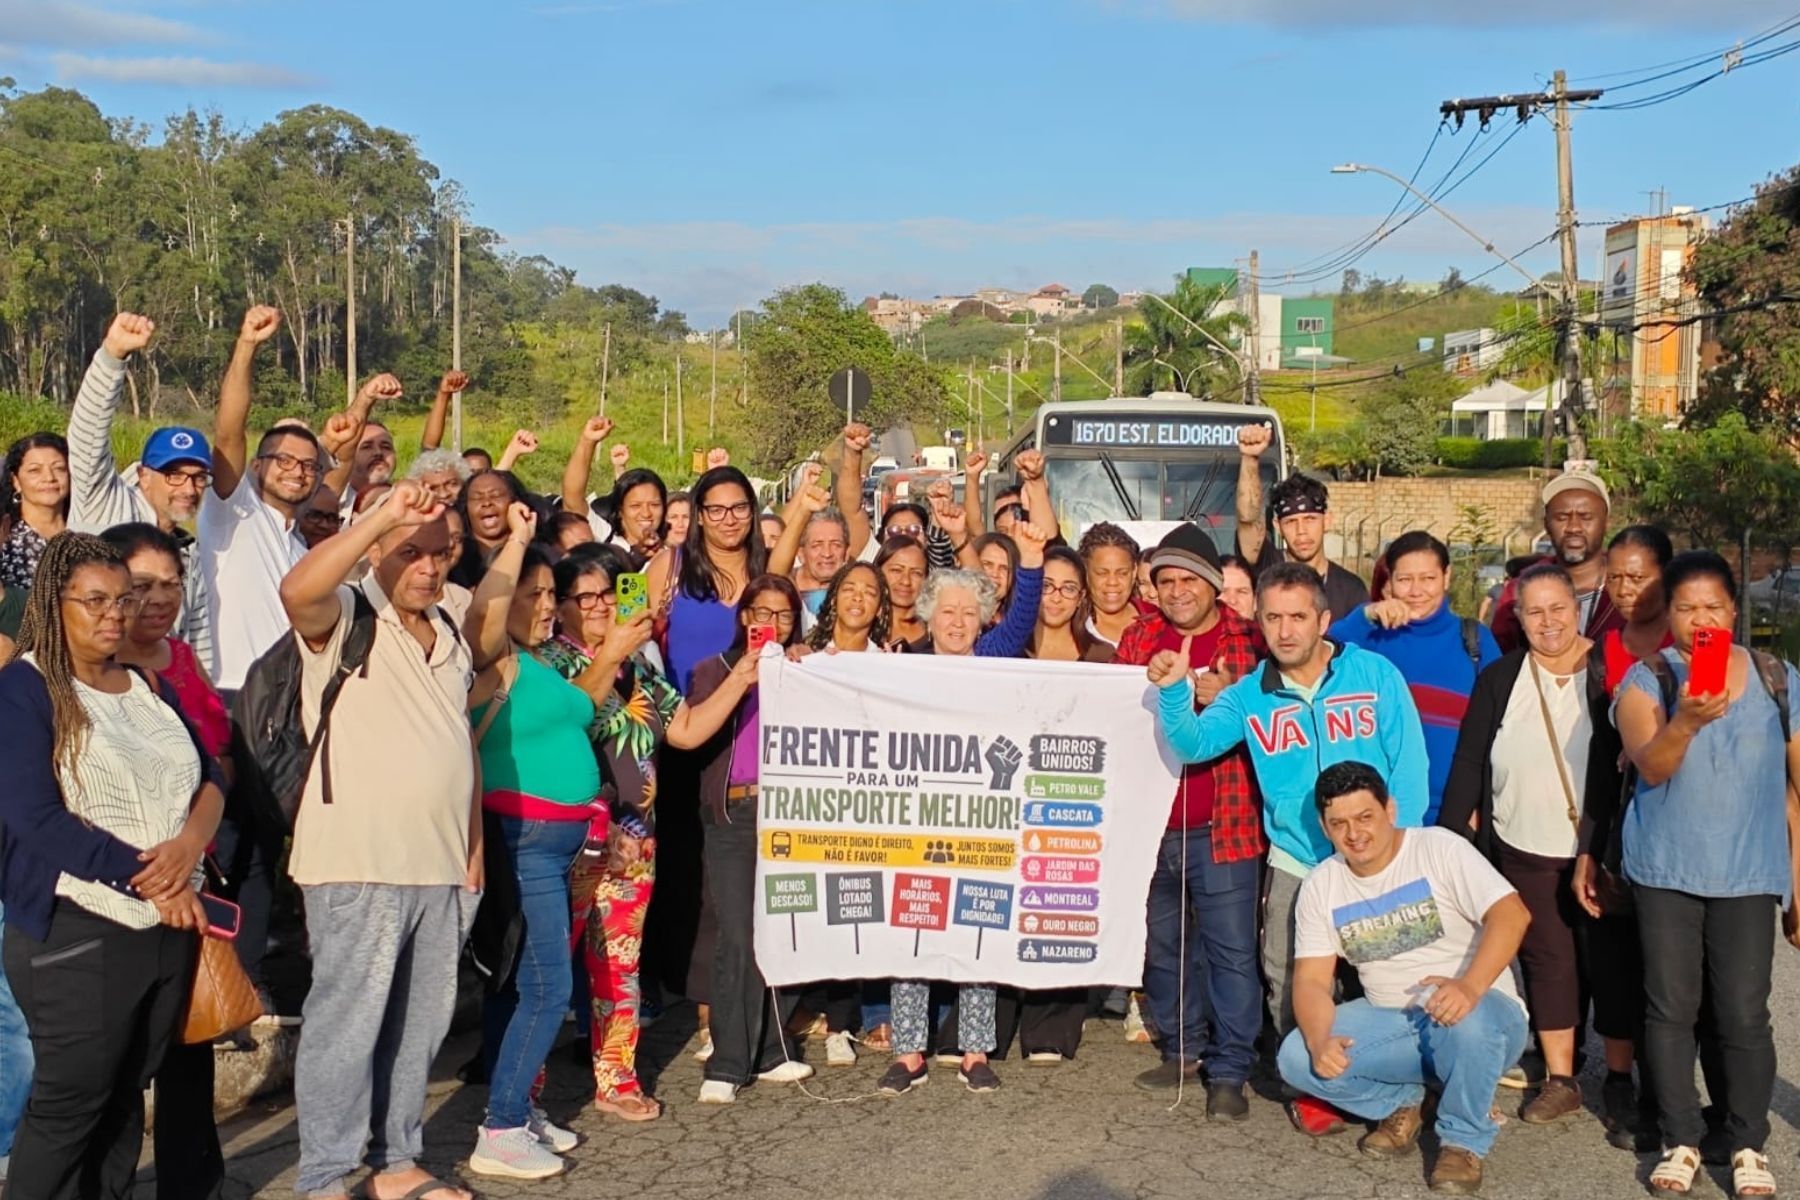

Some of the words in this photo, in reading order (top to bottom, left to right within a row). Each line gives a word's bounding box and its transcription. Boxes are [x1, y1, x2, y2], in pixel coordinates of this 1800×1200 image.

[1076, 423, 1115, 443] 1670
[1119, 423, 1154, 444] EST.
[1248, 705, 1378, 755] VANS
[763, 725, 879, 769] FRENTE
[888, 732, 982, 774] UNIDA
[1040, 738, 1096, 755] BAIRROS
[1041, 754, 1094, 770] UNIDOS!
[847, 772, 889, 786] PARA
[895, 774, 918, 787] UM
[1049, 783, 1076, 794] PETRO
[1078, 785, 1099, 795] VALE
[762, 786, 912, 825] TRANSPORTE
[919, 793, 1020, 830] MELHOR!
[1048, 808, 1094, 822] CASCATA
[798, 834, 848, 847] TRANSPORTE
[849, 837, 874, 848] DIGNO
[875, 836, 880, 848] É
[881, 838, 914, 850] DIREITO,
[956, 841, 985, 852] JUNTOS
[988, 843, 1015, 854] SOMOS
[1047, 837, 1097, 849] PETROLINA
[824, 849, 844, 861] NÃO
[847, 850, 852, 862] É
[855, 851, 887, 863] FAVOR!
[958, 854, 979, 865] MAIS
[981, 855, 1011, 866] FORTES!
[1046, 860, 1077, 870] JARDIM
[1078, 861, 1095, 871] DAS
[1045, 871, 1073, 881] ROSAS
[775, 880, 807, 892] MENOS
[838, 877, 871, 890] ÔNIBUS
[911, 879, 932, 889] MAIS
[900, 889, 943, 903] HORÁRIOS,
[963, 884, 988, 897] NOSSA
[990, 888, 1008, 900] LUTA
[771, 895, 813, 908] DESCASO!
[839, 893, 872, 905] LOTADO
[973, 898, 978, 909] É
[979, 900, 995, 911] POR
[1044, 893, 1093, 905] MONTREAL
[840, 906, 872, 918] CHEGA!
[909, 902, 930, 913] MAIS
[899, 913, 939, 925] RESPEITO!
[961, 909, 1004, 924] DIGNIDADE!
[1340, 903, 1431, 937] STREAMING
[1042, 919, 1066, 931] OURO
[1068, 920, 1096, 931] NEGRO
[1042, 945, 1092, 958] NAZARENO
